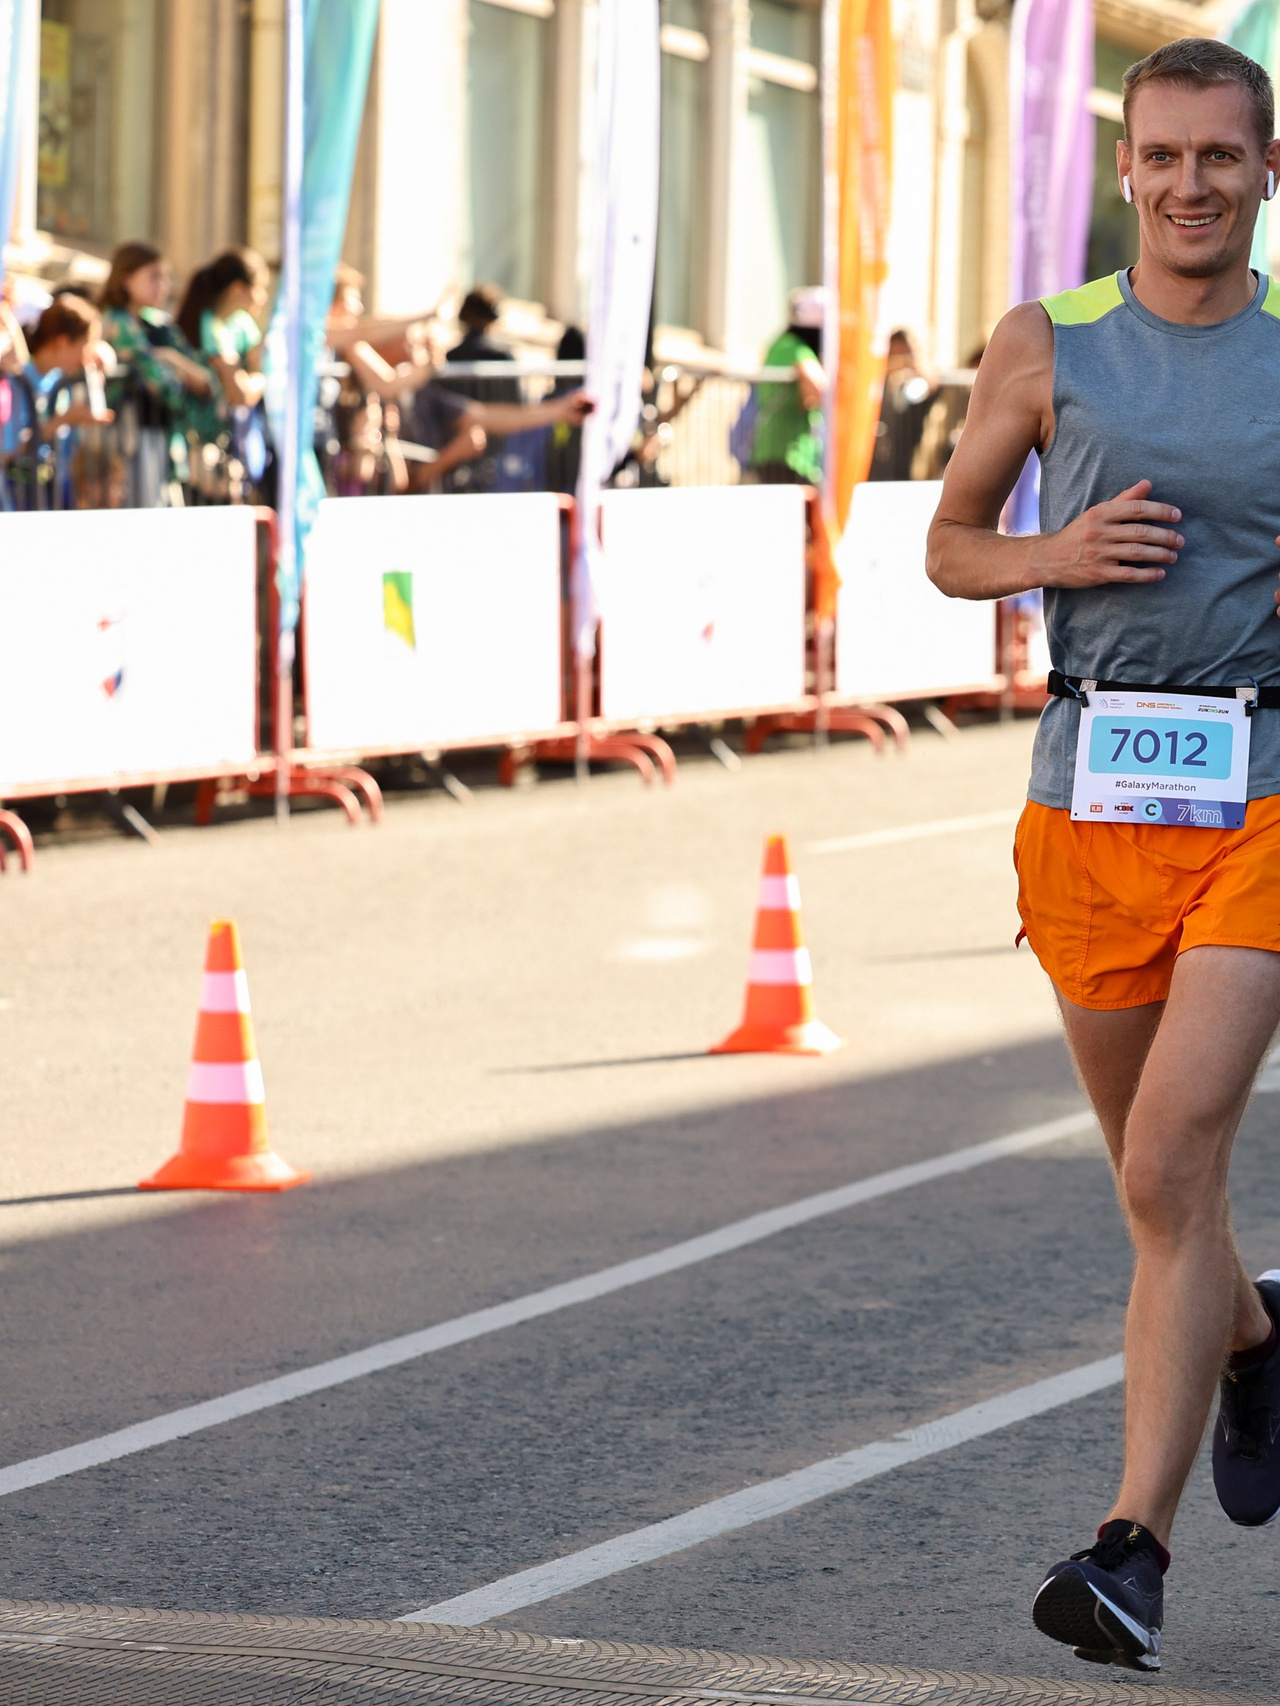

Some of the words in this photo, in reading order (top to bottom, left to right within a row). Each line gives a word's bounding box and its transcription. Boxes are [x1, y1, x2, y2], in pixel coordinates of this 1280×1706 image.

[1136, 701, 1156, 709] DNS
[1110, 728, 1208, 767] 7012
[1115, 779, 1197, 793] #GalaxyMarathon
[1177, 803, 1223, 824] 7km
